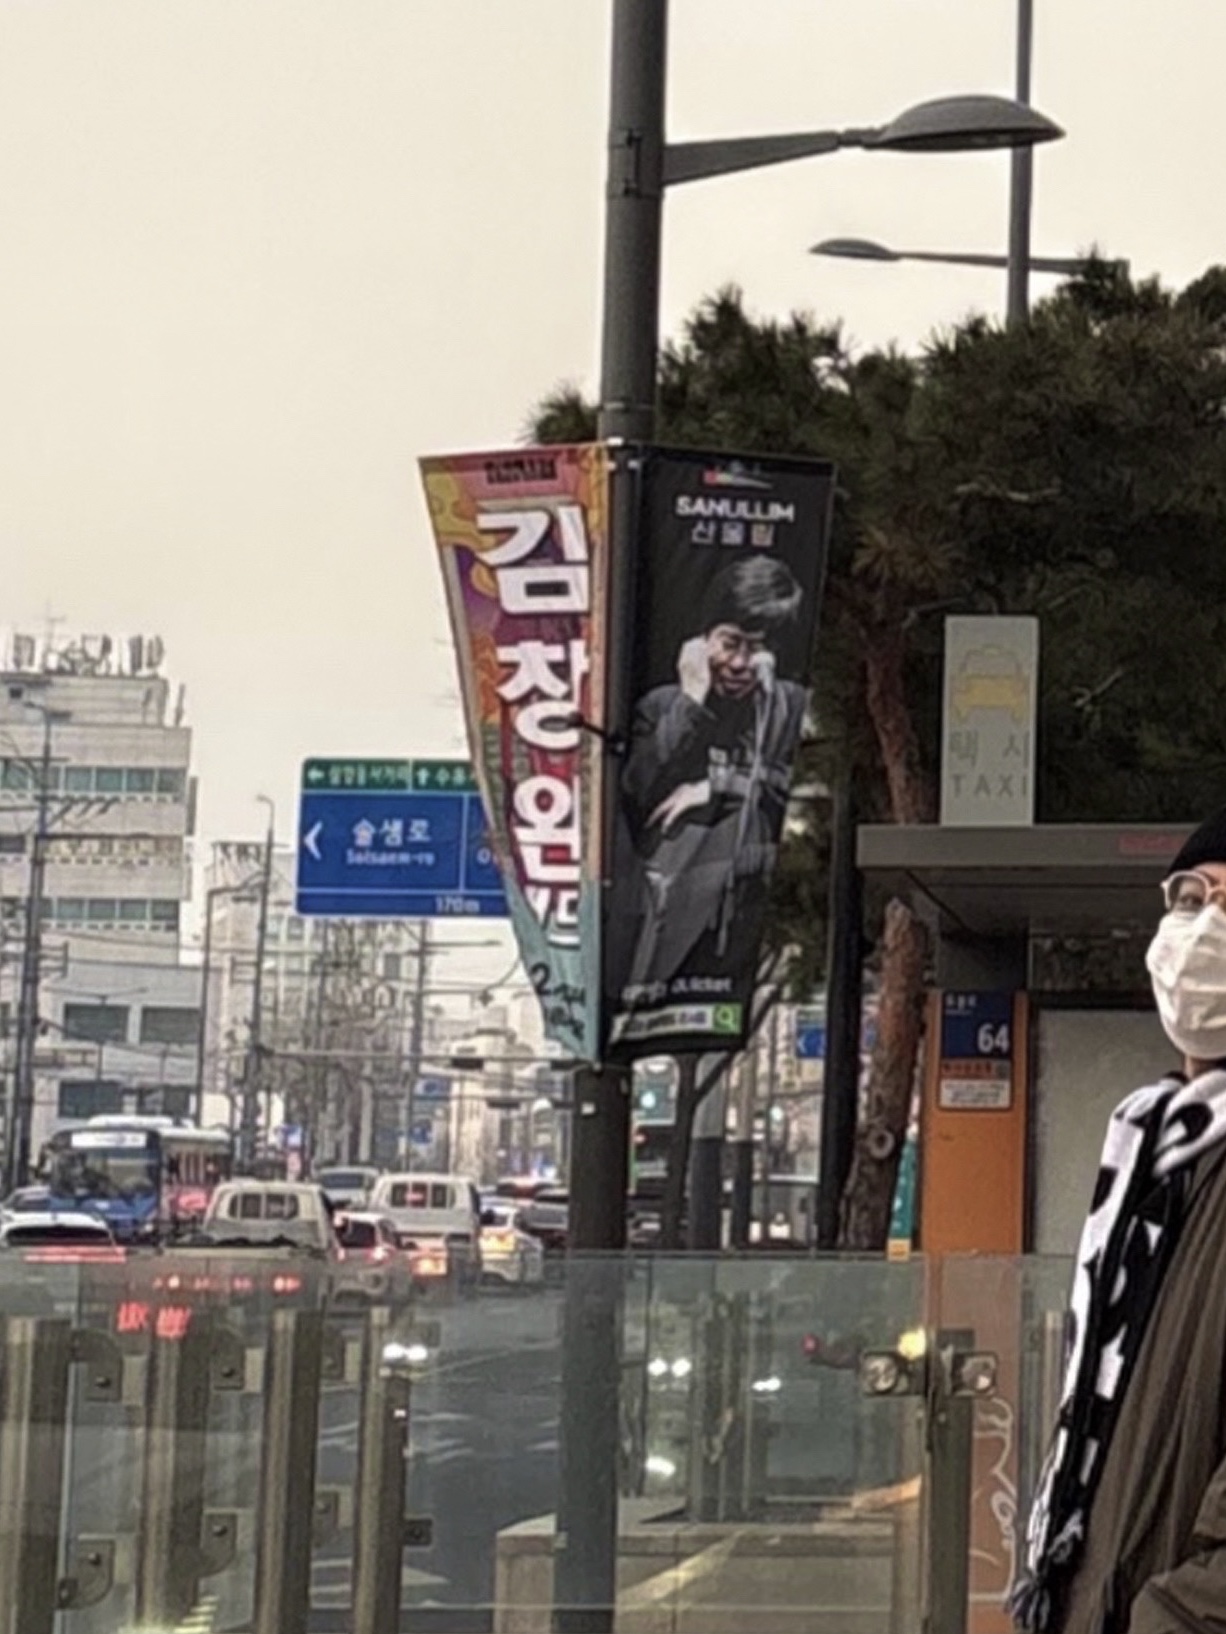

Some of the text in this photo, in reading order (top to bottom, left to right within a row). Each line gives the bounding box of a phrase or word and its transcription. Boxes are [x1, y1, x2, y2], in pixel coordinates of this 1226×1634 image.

[676, 496, 795, 522] SANULLIM
[950, 729, 1030, 768] 택시
[950, 773, 1029, 799] TAXI
[977, 1022, 1010, 1054] 64
